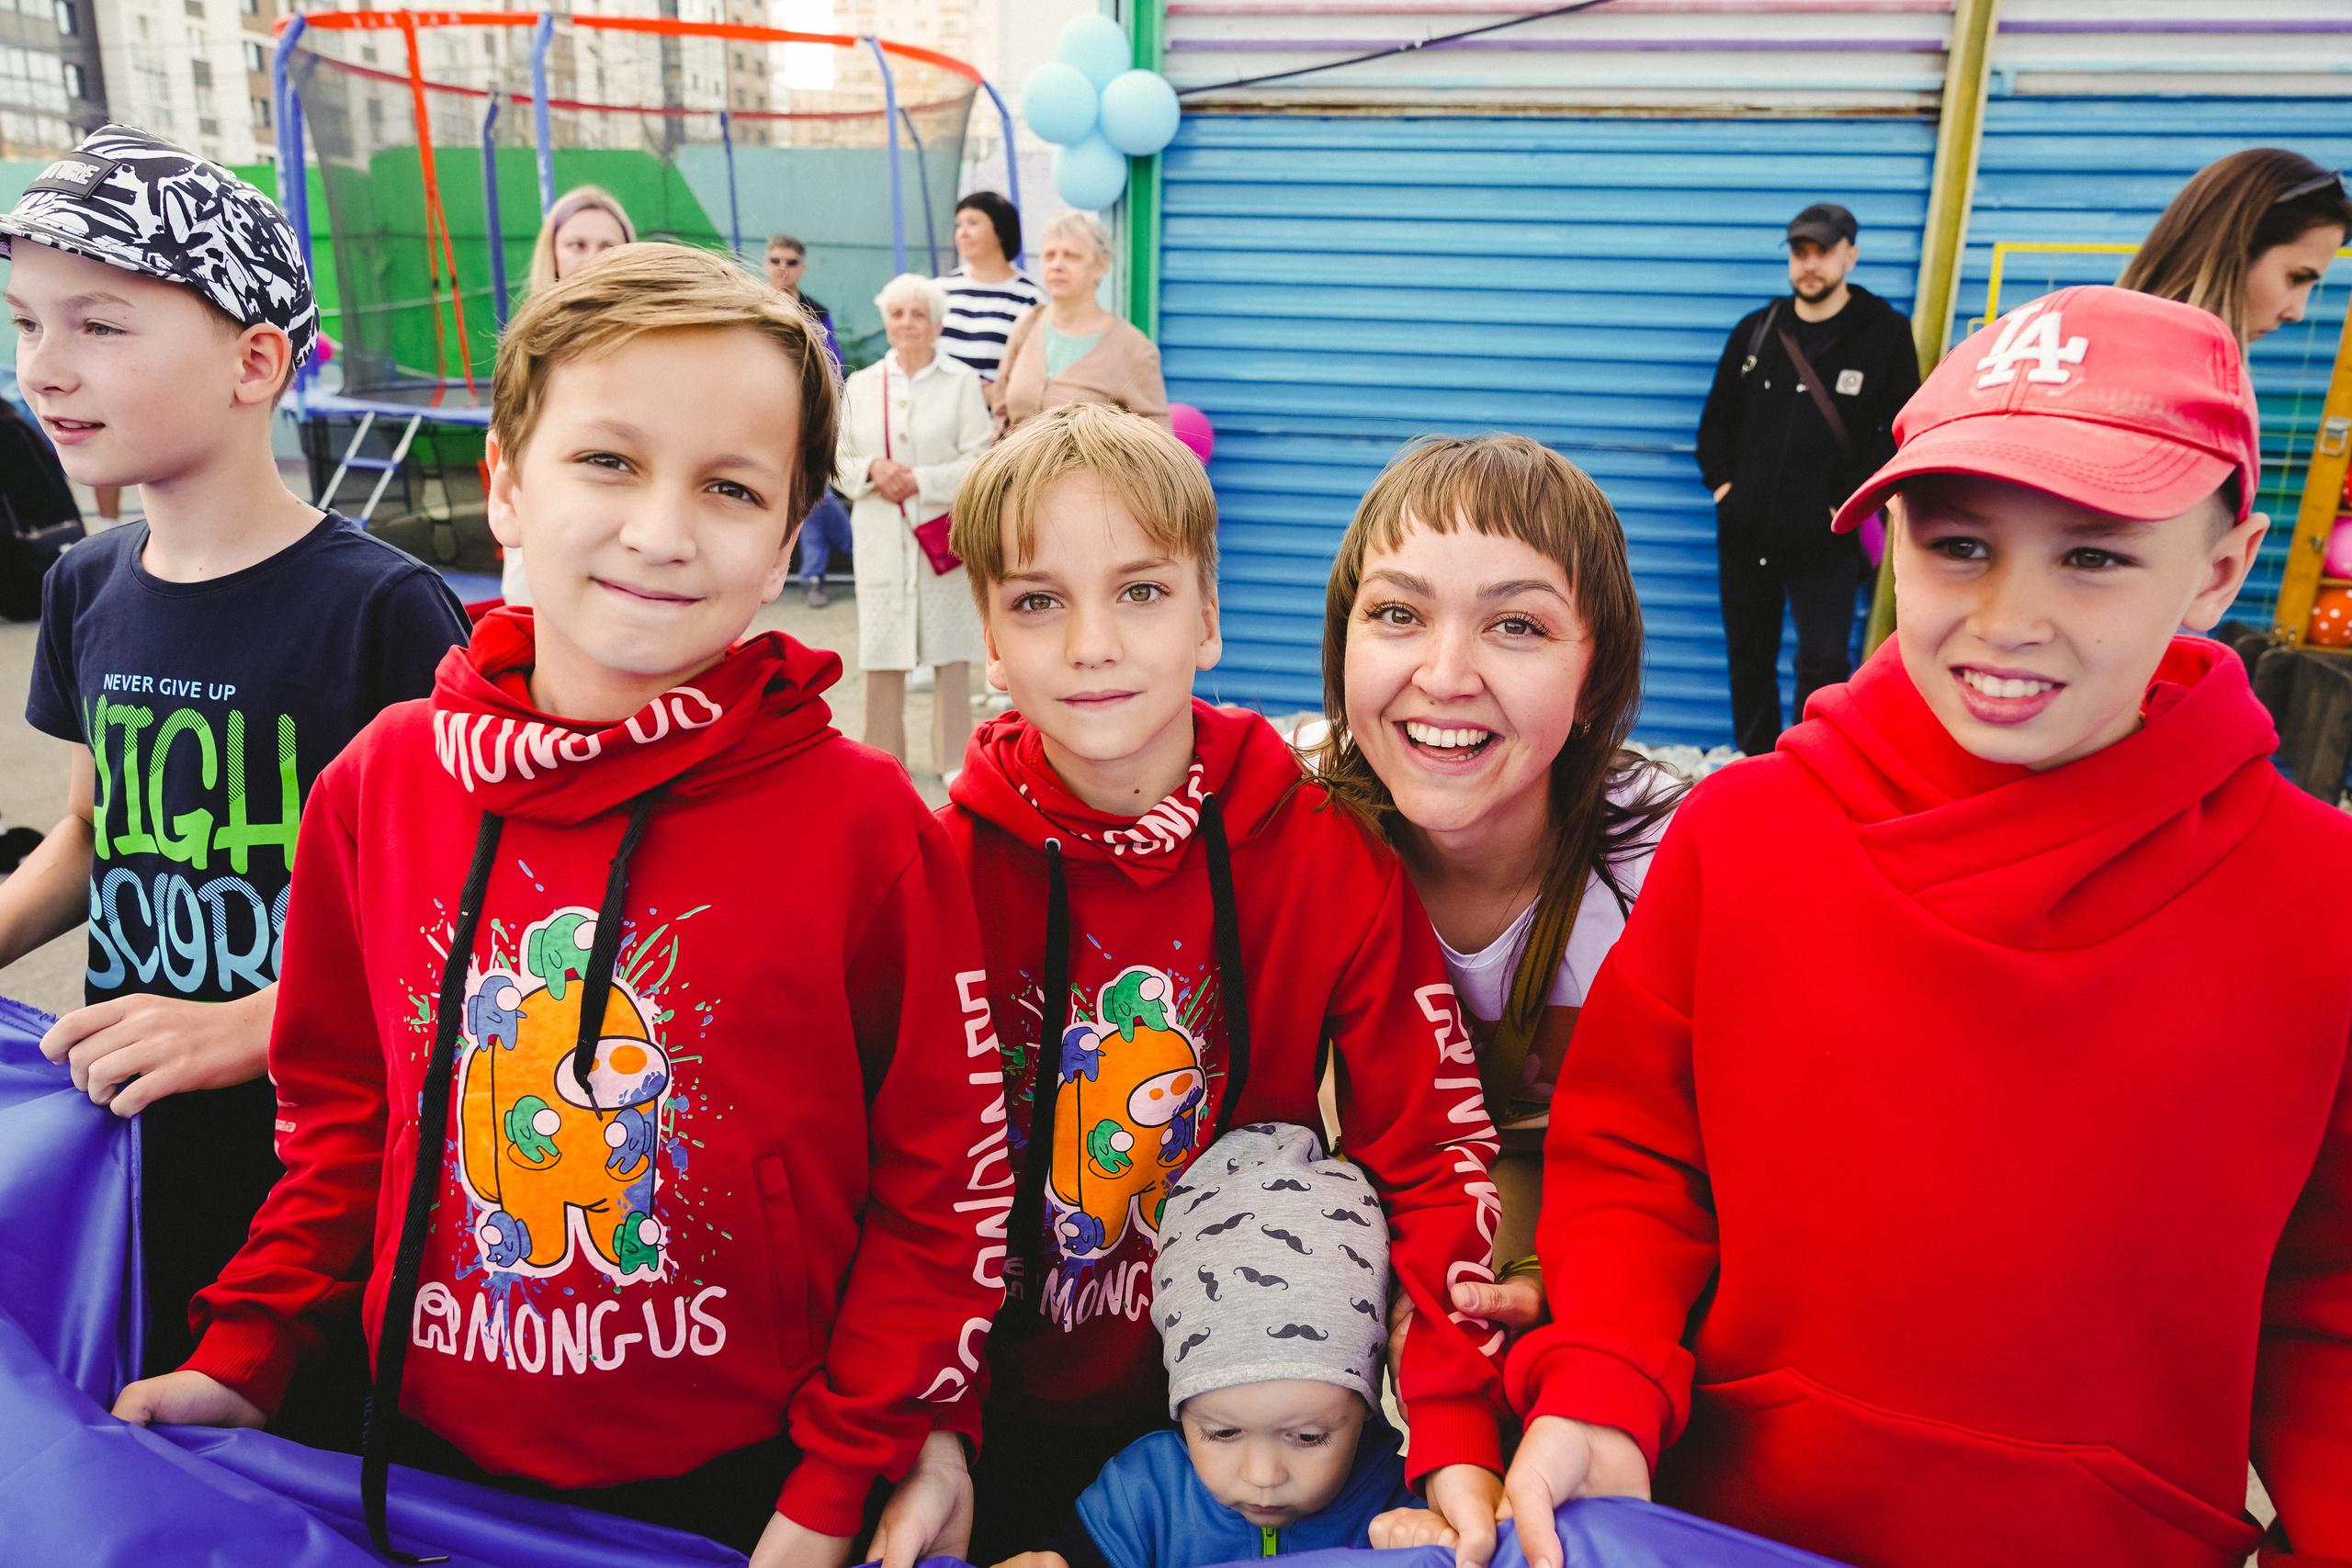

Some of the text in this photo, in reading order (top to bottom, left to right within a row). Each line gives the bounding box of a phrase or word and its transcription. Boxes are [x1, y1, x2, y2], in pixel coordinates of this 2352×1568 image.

[1976, 302, 2089, 389] LA
[103, 673, 236, 701] NEVER GIVE UP
[641, 1286, 728, 1359] US
